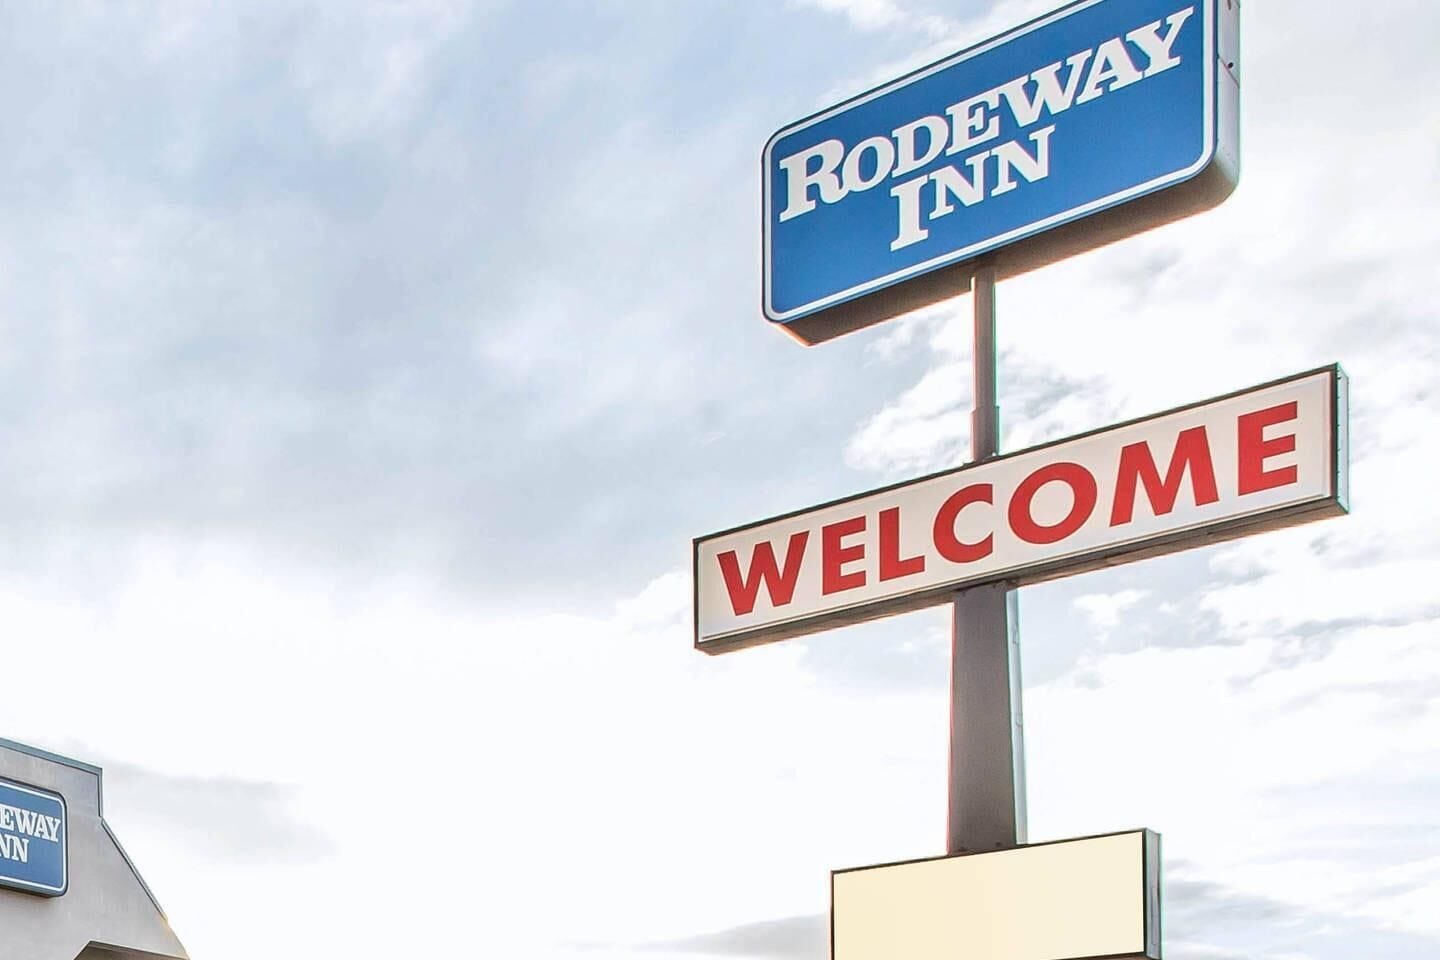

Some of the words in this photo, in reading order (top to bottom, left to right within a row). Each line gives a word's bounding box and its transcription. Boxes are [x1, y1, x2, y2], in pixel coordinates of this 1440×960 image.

[778, 6, 1196, 223] RODEWAY
[890, 123, 1057, 252] INN
[716, 399, 1300, 617] WELCOME
